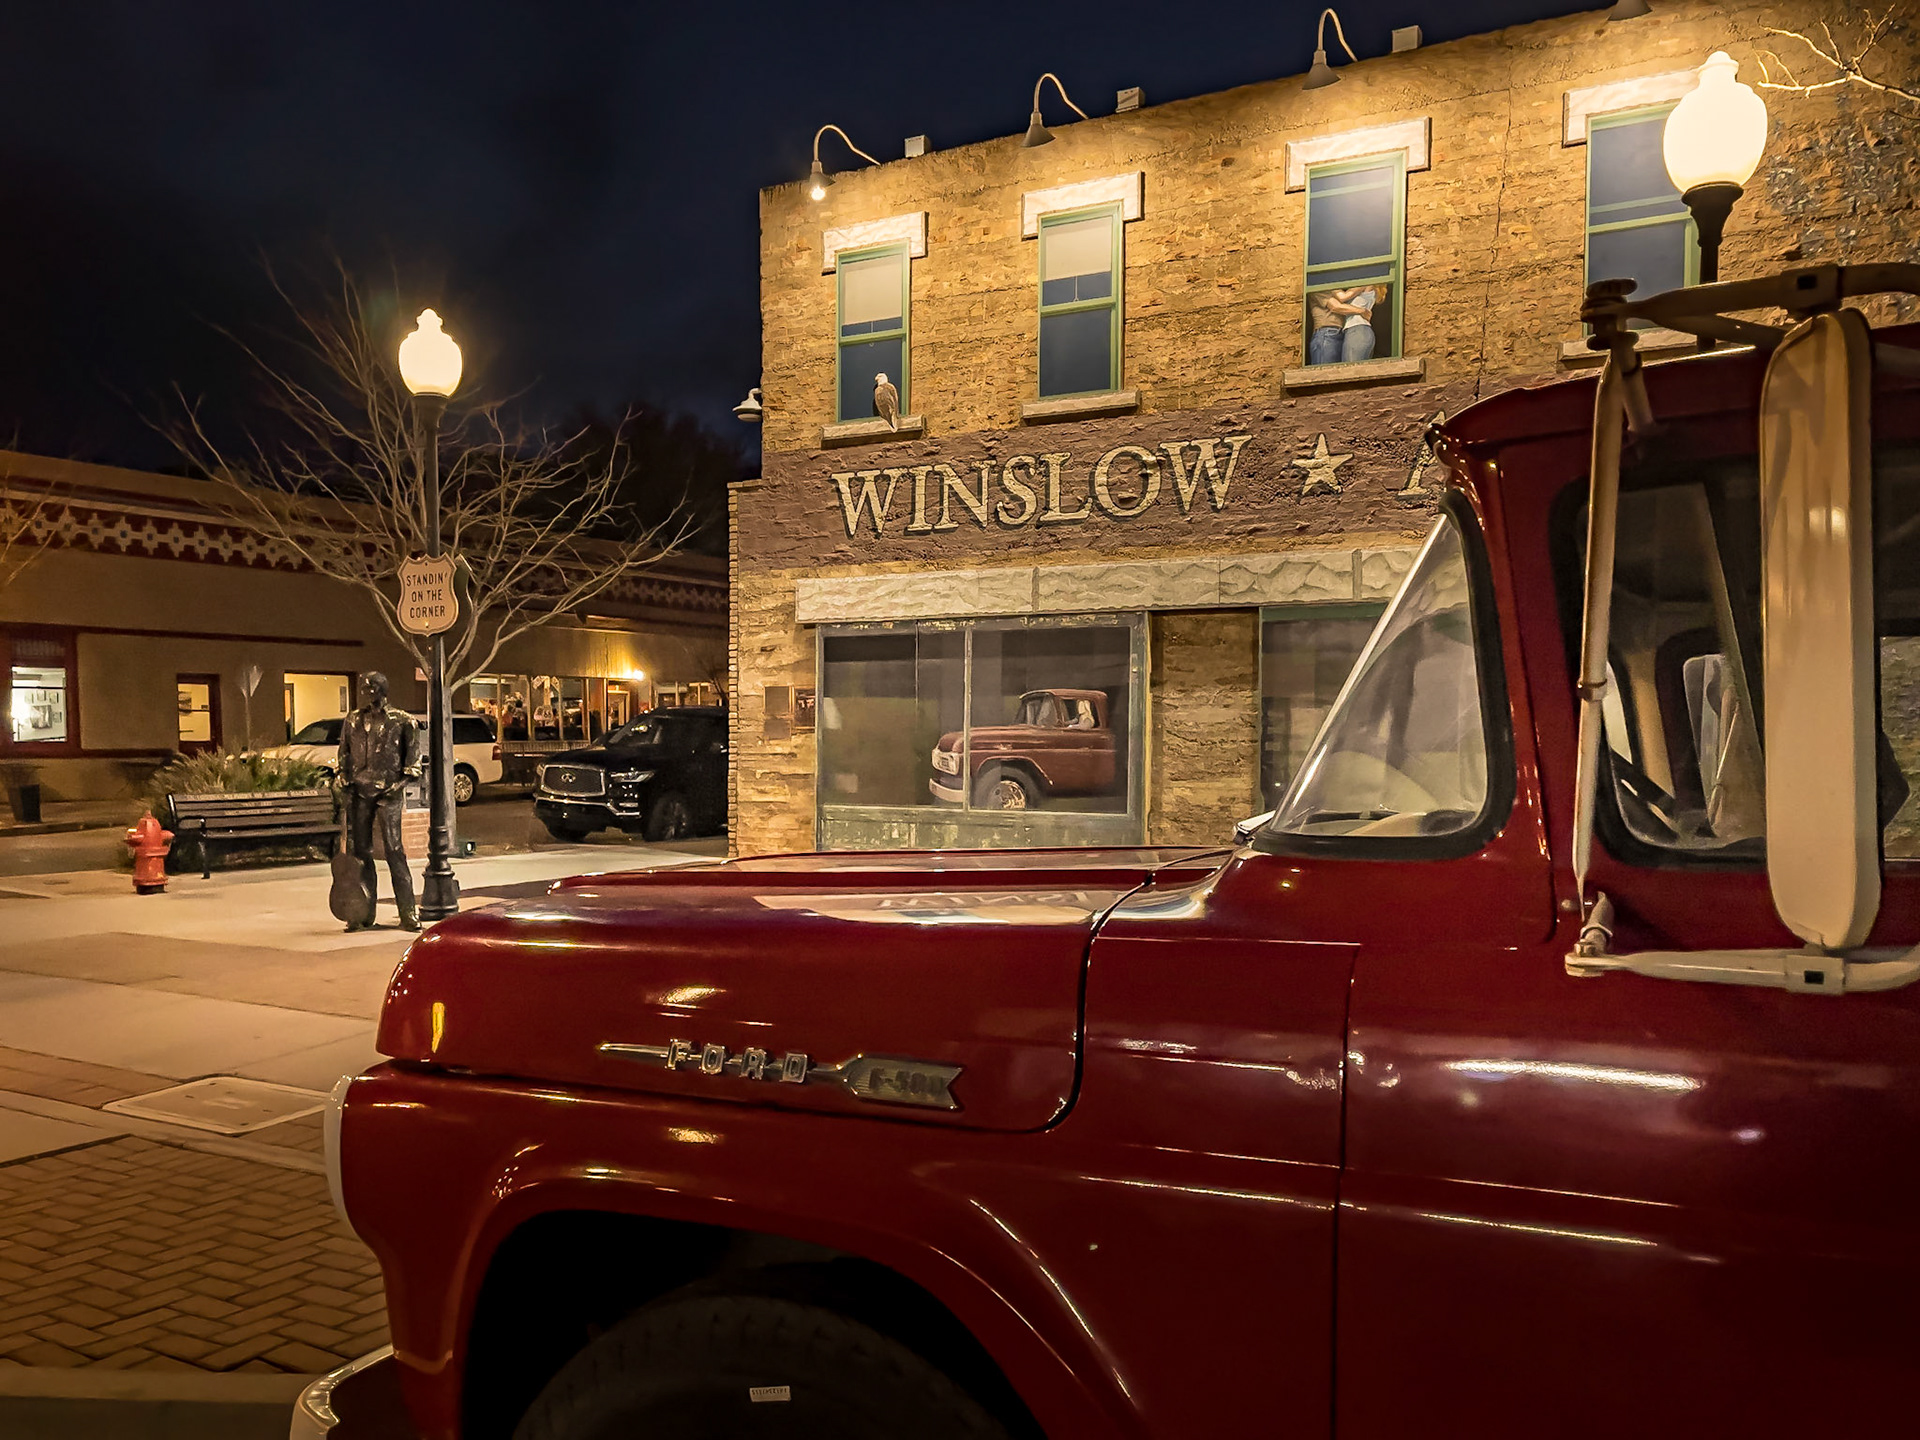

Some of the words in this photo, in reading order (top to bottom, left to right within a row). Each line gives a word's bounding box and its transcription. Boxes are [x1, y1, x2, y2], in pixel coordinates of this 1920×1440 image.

[831, 434, 1253, 537] WINSLOW
[406, 571, 448, 587] STANDIN'
[411, 591, 423, 602] ON
[426, 589, 443, 601] THE
[409, 605, 446, 619] CORNER
[664, 1037, 809, 1084] FORD
